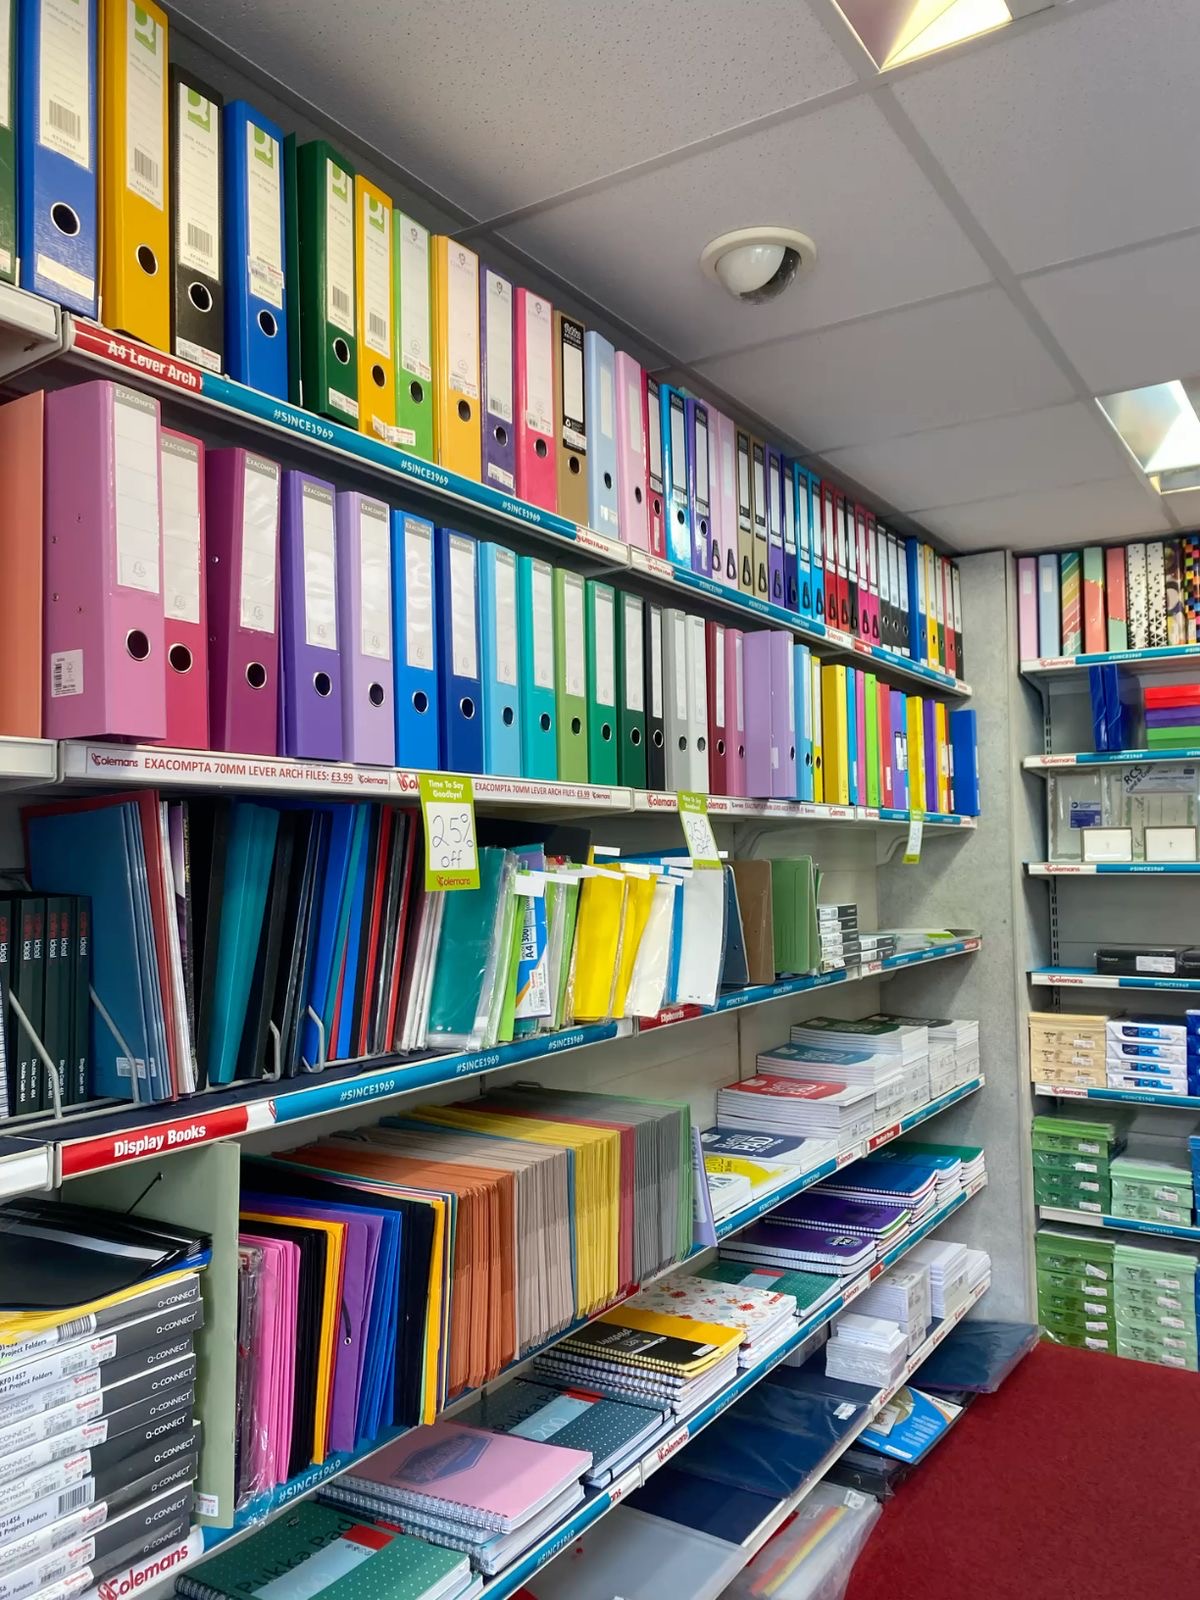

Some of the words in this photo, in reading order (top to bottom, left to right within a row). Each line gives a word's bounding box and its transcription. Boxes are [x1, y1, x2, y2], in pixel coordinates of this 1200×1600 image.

[107, 340, 126, 360] A4
[129, 348, 167, 374] Lever
[167, 365, 197, 388] Arch
[115, 389, 156, 410] EXACOMPTA
[273, 409, 334, 440] #SINCE1969
[401, 459, 449, 485] #SINCE1969
[502, 500, 541, 523] #SINCE1969
[92, 753, 138, 768] Colemans
[144, 758, 211, 773] EXACOMPTA
[214, 763, 246, 775] 70MM
[249, 766, 277, 778] LEVER
[279, 767, 303, 779] ARCH
[306, 770, 329, 781] FILES:
[331, 772, 353, 784] £3.99
[358, 774, 388, 785] Colemans
[428, 780, 443, 788] Time
[445, 780, 452, 788] To
[452, 781, 464, 791] Say
[1123, 766, 1143, 785] RCS
[432, 790, 462, 800] Goodbye!
[647, 792, 677, 808] Colemans
[432, 813, 474, 848] 25%
[525, 944, 534, 959] A4
[548, 1034, 584, 1050] #SINCE1969
[456, 1054, 500, 1074] #SINCE1969
[339, 1079, 395, 1101] #SINCE1969
[113, 1134, 165, 1158] Display
[167, 1124, 206, 1145] Books
[1, 1346, 23, 1359] Project
[25, 1339, 47, 1351] Folders
[9, 1379, 31, 1391] Project
[278, 1459, 342, 1504] #SINCE1969
[4, 1522, 25, 1535] Project
[235, 1551, 311, 1594] Pukka
[309, 1518, 356, 1548] Pad
[536, 1529, 575, 1566] #SINCE1969
[98, 1544, 188, 1600] Colemans
